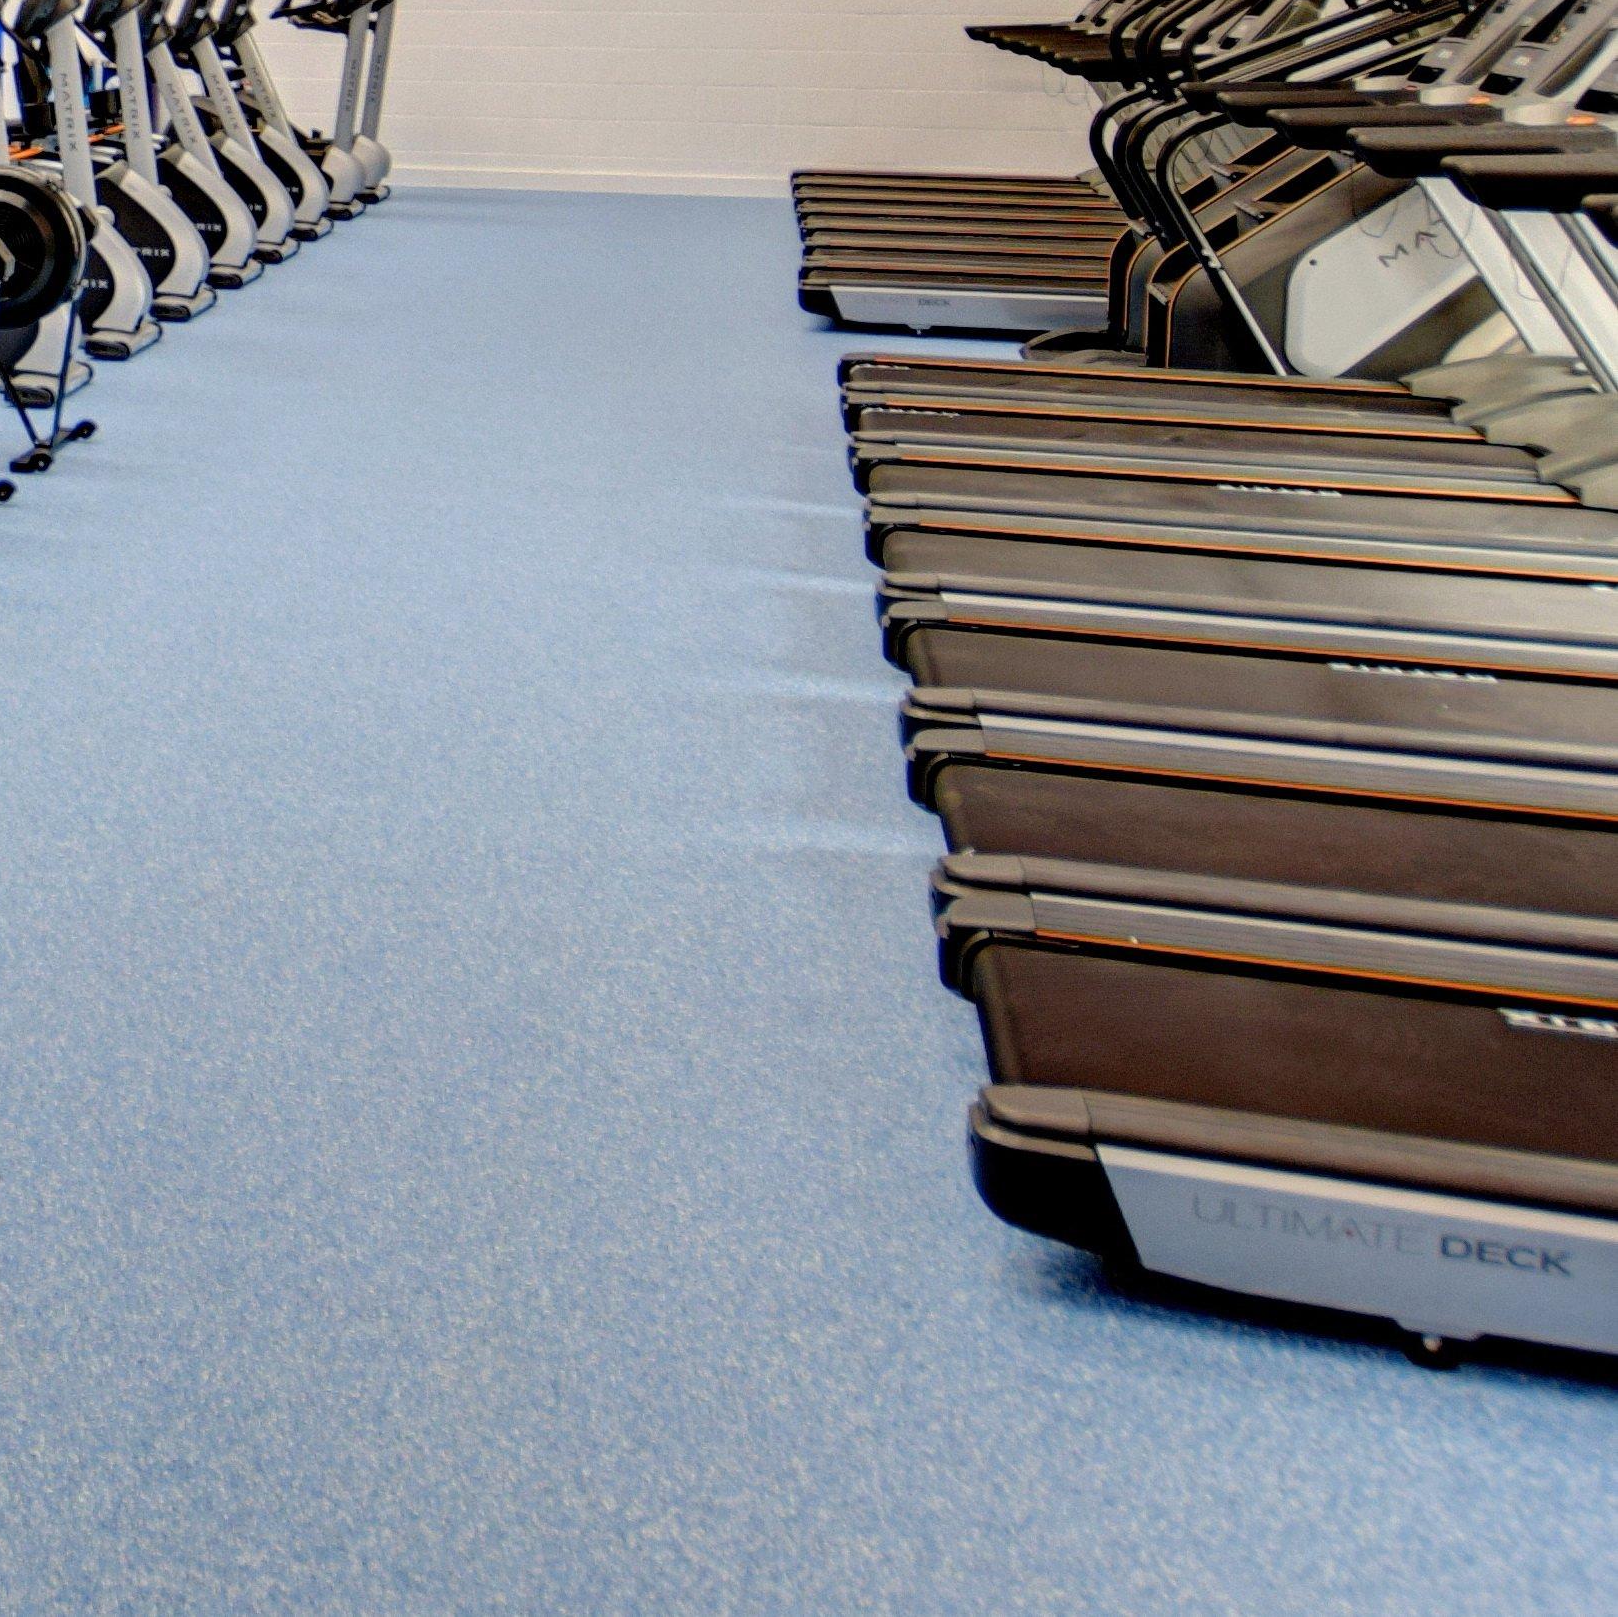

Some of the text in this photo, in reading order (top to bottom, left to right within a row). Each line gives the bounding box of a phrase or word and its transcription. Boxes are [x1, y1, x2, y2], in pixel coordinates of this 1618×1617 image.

[58, 71, 78, 152] MATRIX
[1192, 1195, 1575, 1279] ULTIMATE DECK
